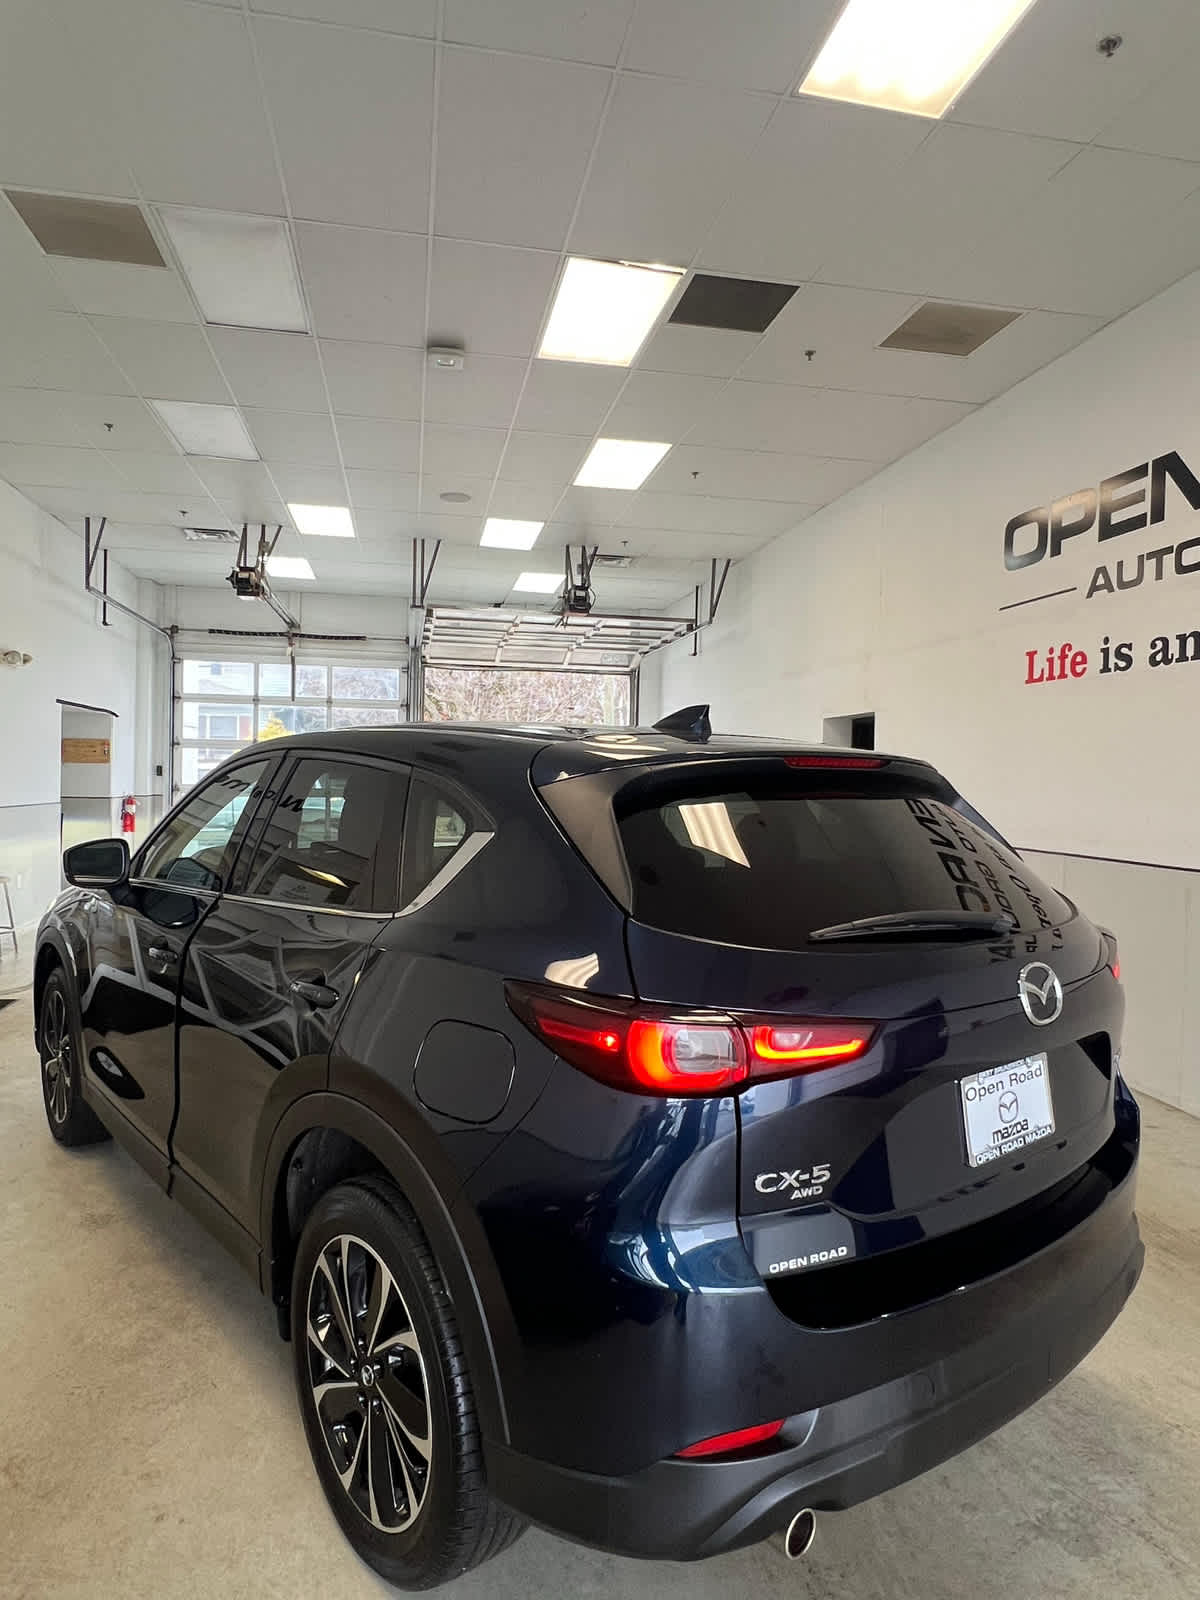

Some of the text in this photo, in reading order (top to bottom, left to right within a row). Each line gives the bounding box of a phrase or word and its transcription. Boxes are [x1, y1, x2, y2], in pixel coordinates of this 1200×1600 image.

[1025, 643, 1088, 684] Life
[1099, 636, 1133, 674] is
[965, 1080, 1005, 1102] Open
[1008, 1064, 1042, 1087] Road
[976, 1125, 1052, 1164] OPEN ROAD MAZDA
[992, 1118, 1029, 1144] mazda
[755, 1163, 831, 1193] CX-5
[790, 1185, 824, 1200] AWD
[769, 1246, 848, 1274] OPEN ROAD
